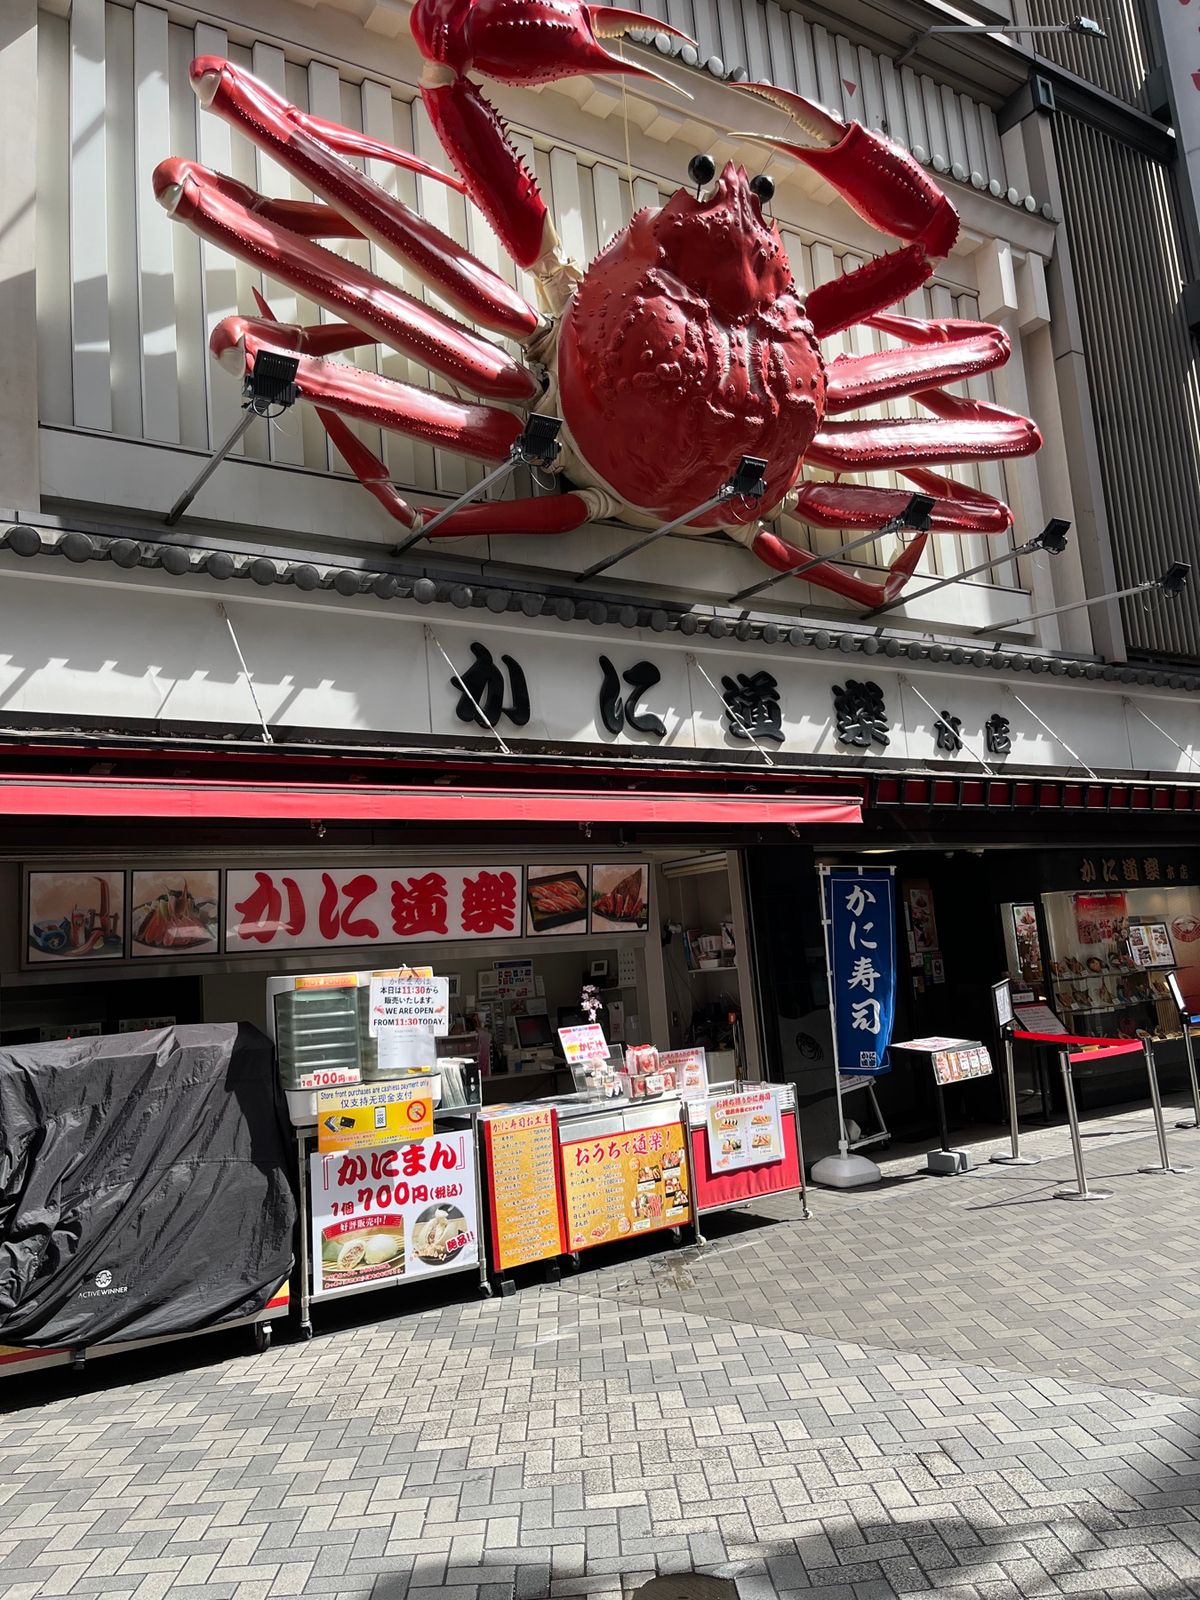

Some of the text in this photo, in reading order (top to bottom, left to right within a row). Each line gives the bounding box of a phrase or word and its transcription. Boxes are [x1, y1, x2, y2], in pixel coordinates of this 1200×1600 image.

[845, 885, 881, 1035] かに寿司
[380, 986, 439, 994] 本日は11:30から
[384, 996, 434, 1005] 販売いたします。
[320, 1091, 334, 1100] Store
[335, 1090, 347, 1099] front
[348, 1088, 372, 1098] purchases
[381, 1084, 400, 1093] cashless
[401, 1082, 419, 1092] payment
[420, 1080, 430, 1088] only
[340, 1091, 413, 1109] 仅支持无现金支付
